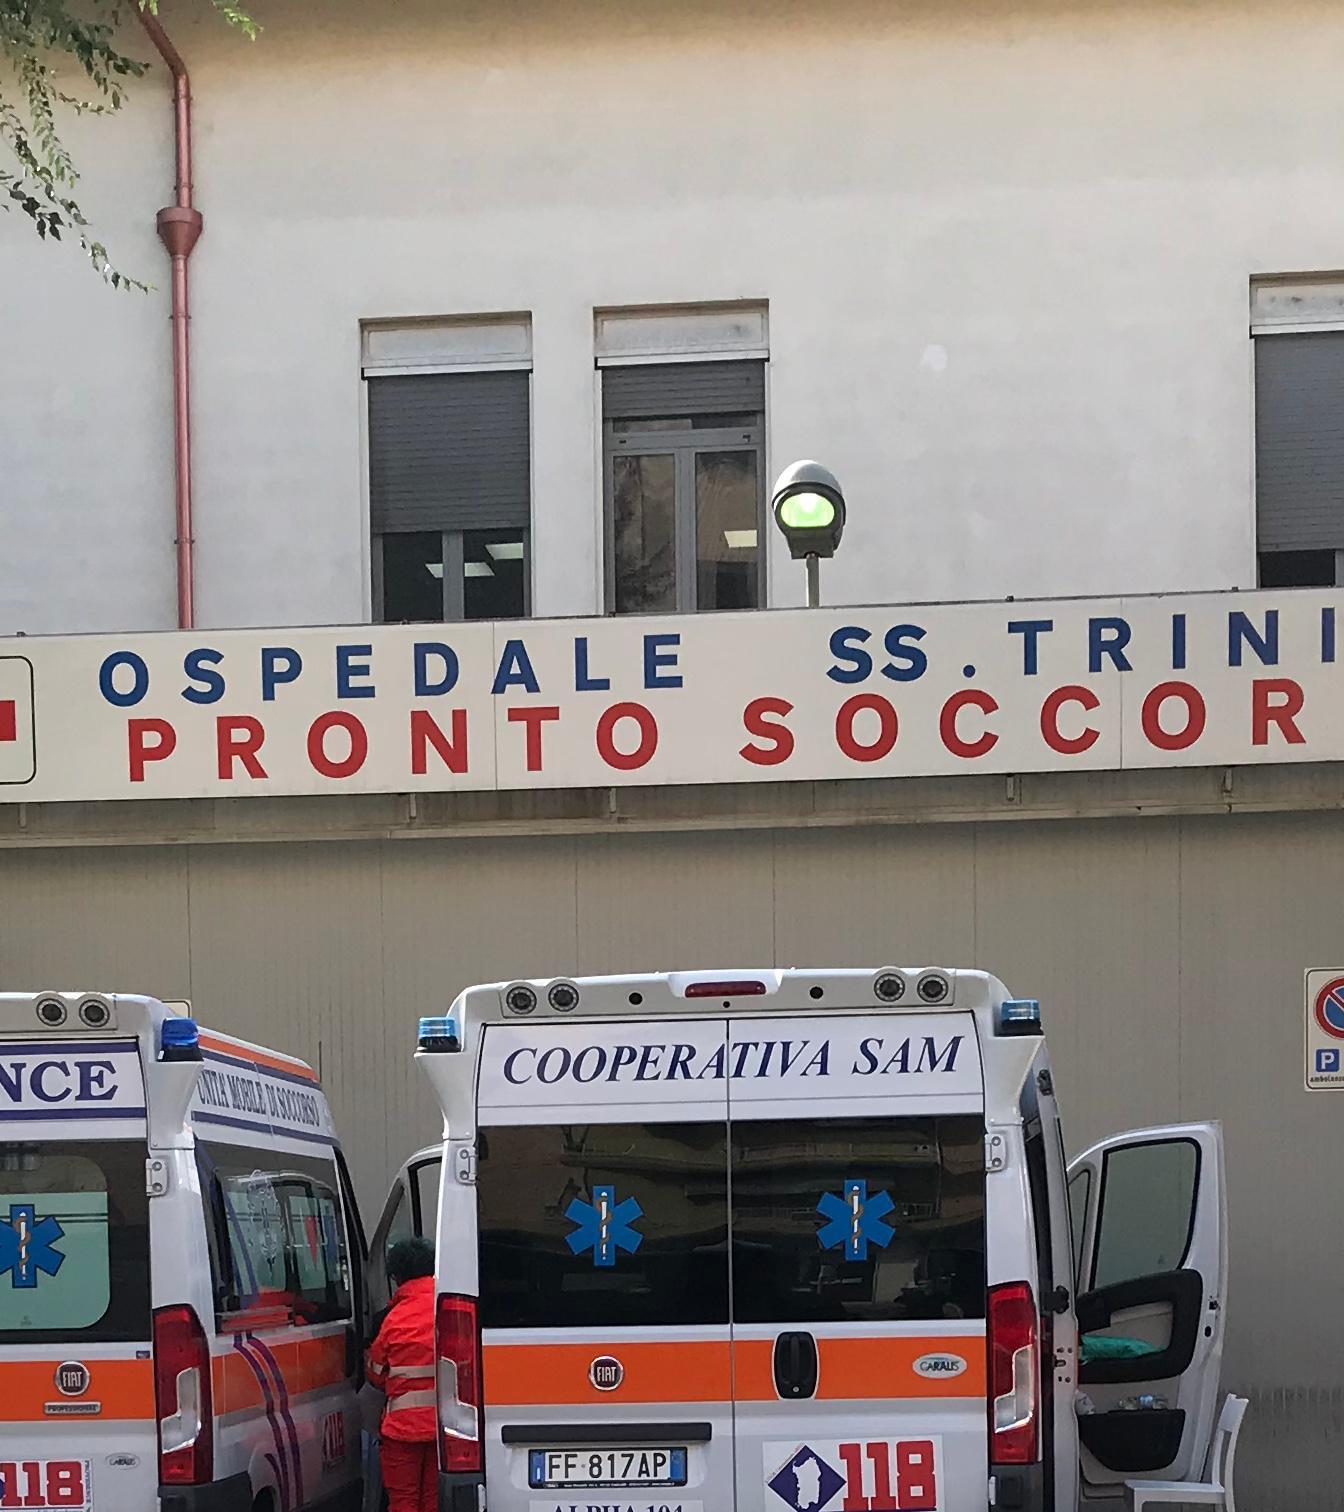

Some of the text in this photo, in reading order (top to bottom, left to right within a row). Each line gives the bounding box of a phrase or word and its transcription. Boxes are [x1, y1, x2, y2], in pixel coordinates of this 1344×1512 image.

[99, 633, 684, 707] OSPEDALE
[127, 701, 660, 783] PRONTO
[503, 1035, 965, 1084] COOPERATIVA SAM
[1320, 1051, 1336, 1070] P
[227, 1075, 267, 1115] MOBILE
[277, 1086, 321, 1127] SOCCORSO
[62, 1371, 83, 1387] FIAT
[596, 1366, 617, 1382] FIAT
[0, 1460, 85, 1507] 118
[548, 1453, 578, 1479] FF
[588, 1452, 667, 1479] 817AP
[838, 1439, 937, 1512] 118
